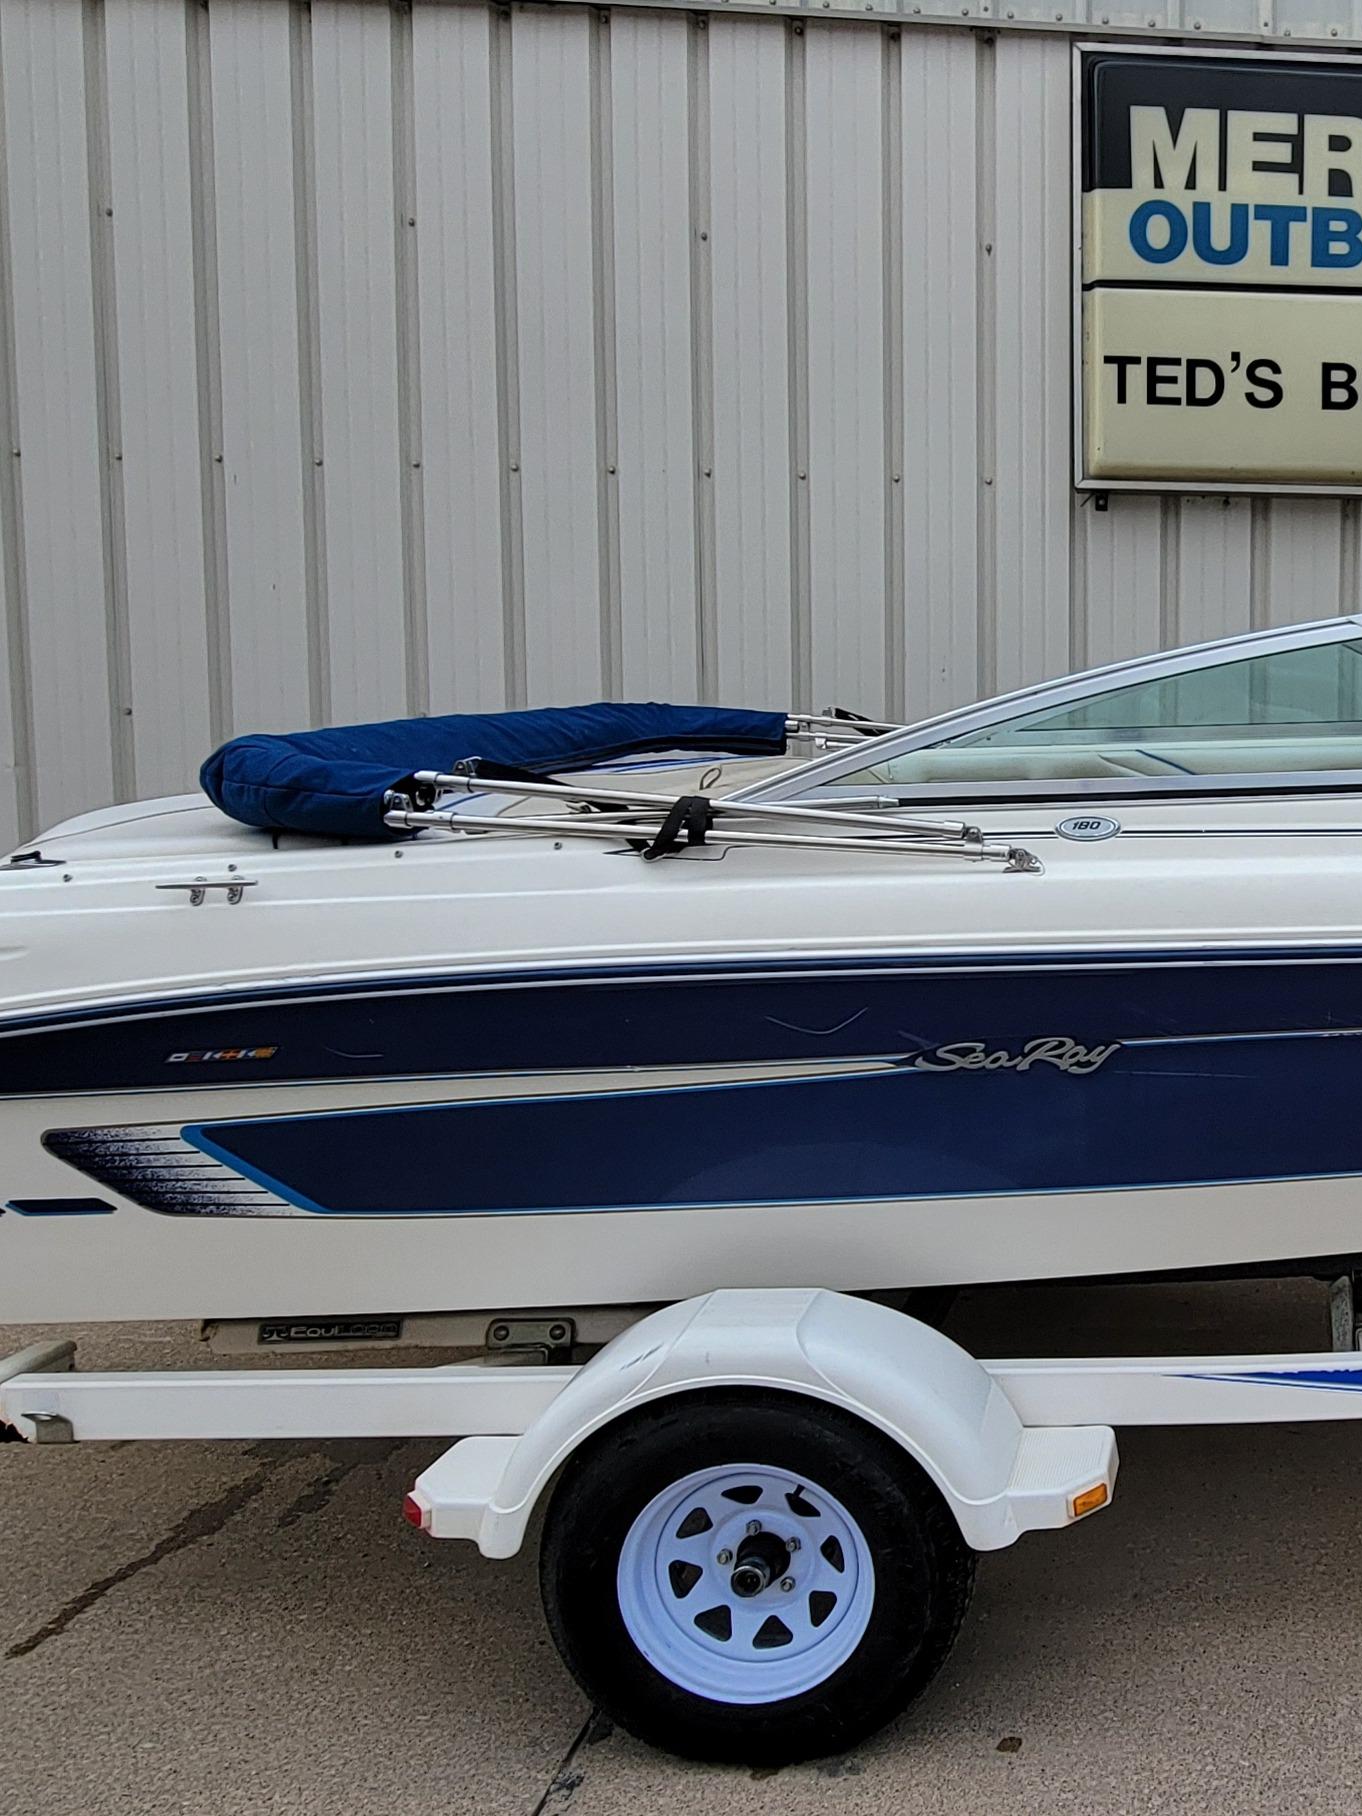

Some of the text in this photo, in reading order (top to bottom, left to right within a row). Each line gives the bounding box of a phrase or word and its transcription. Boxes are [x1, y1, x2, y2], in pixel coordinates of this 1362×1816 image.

[1103, 351, 1284, 410] TED'S
[1072, 820, 1102, 831] 180
[914, 1037, 1121, 1075] Sea Ray
